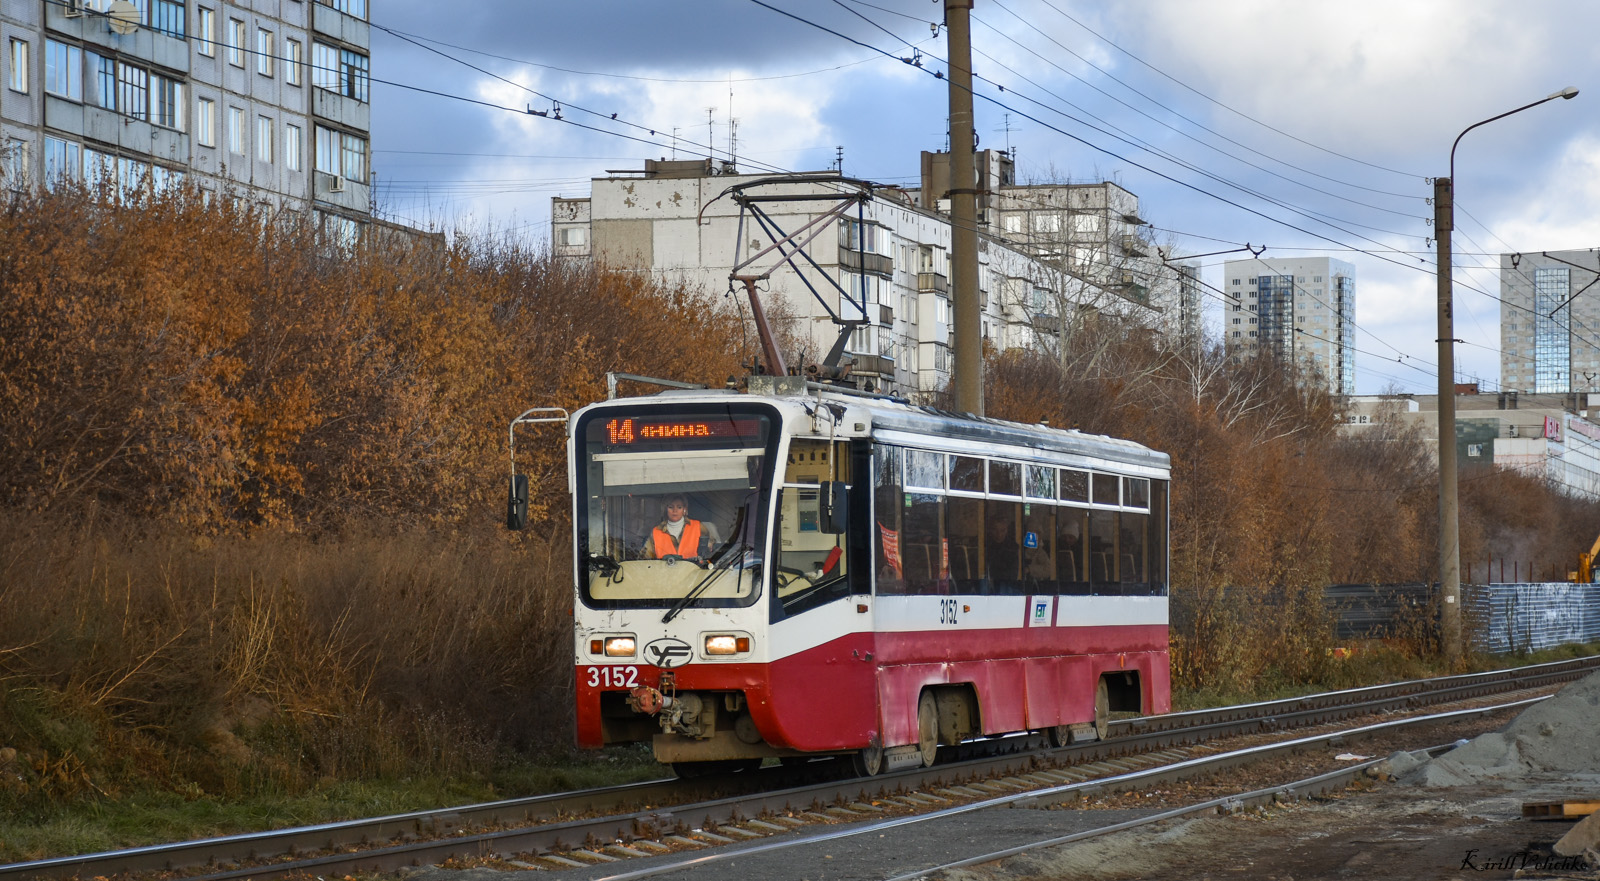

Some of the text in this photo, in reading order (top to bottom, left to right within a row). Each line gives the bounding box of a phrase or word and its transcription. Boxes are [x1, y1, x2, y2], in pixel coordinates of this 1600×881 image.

[606, 419, 634, 444] 14
[940, 598, 958, 625] 3152
[587, 666, 639, 688] 3152
